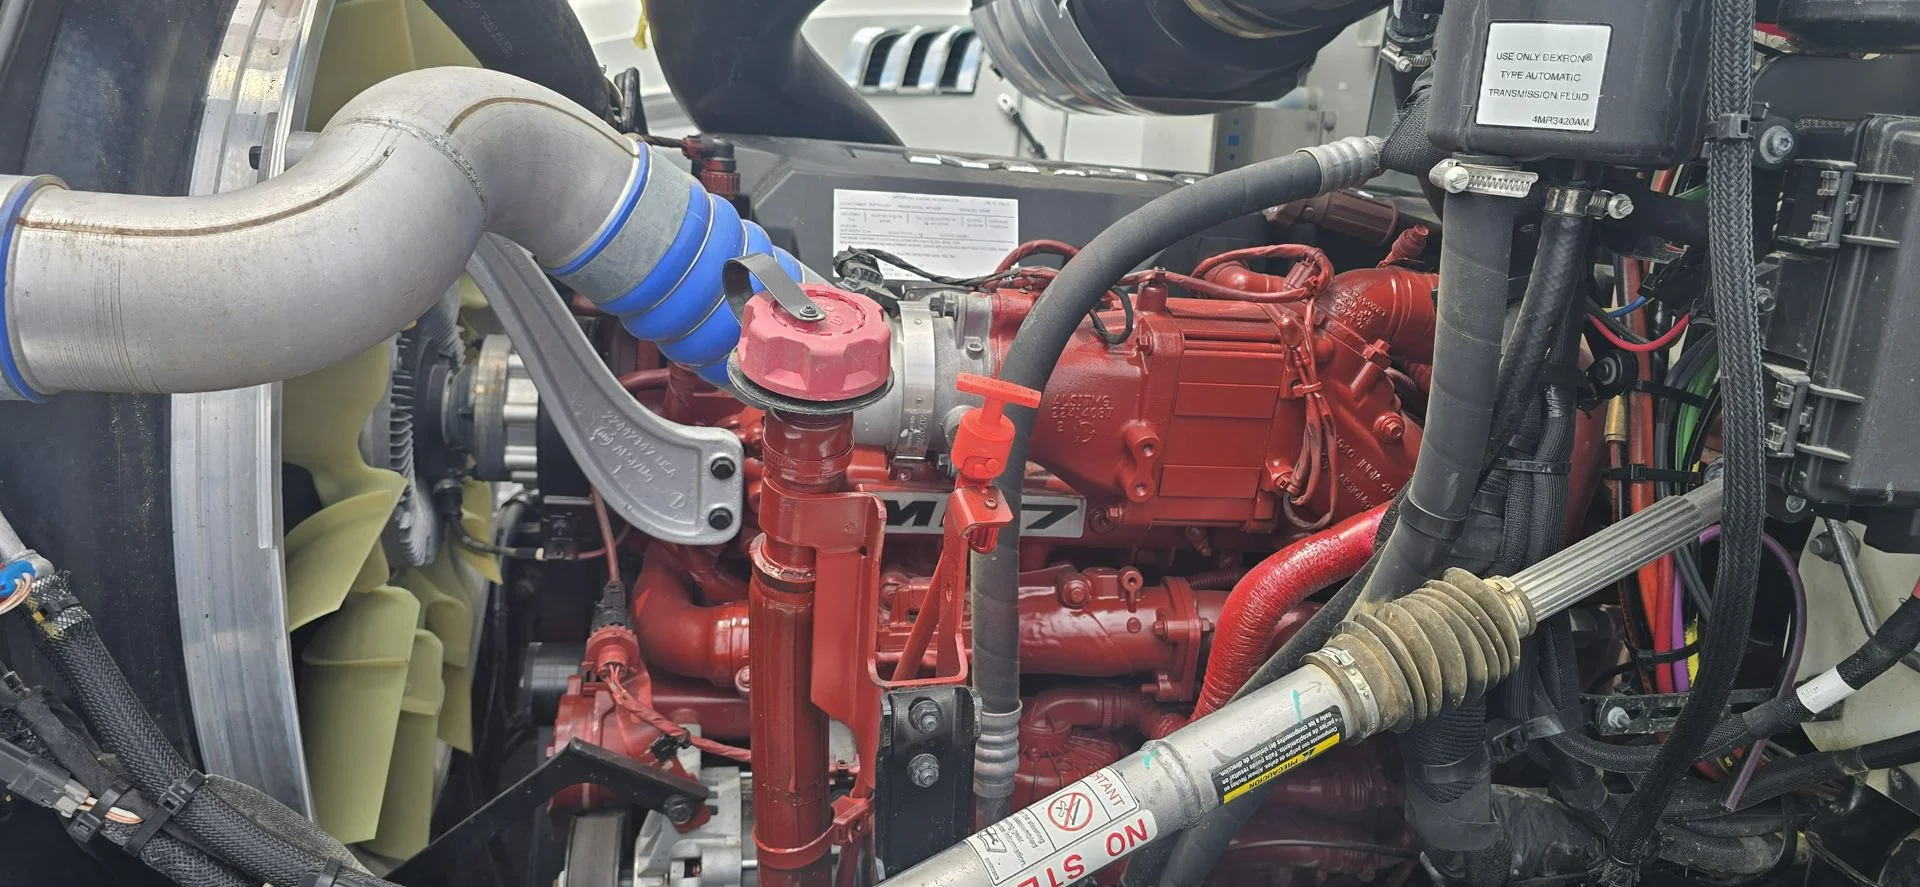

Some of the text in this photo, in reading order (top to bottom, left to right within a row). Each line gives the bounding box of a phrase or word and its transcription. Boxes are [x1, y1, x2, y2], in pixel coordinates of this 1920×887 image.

[1496, 52, 1514, 60] USE
[1516, 52, 1540, 61] ONLY
[1500, 71, 1581, 82] TYPE AUTOMATIC
[1488, 88, 1589, 101] TRANSMISSION FLUID
[1532, 116, 1590, 126] 4MR3420AM
[1307, 720, 1316, 728] los
[1318, 718, 1335, 731] partes
[1276, 723, 1308, 745] componentes
[1310, 726, 1338, 744] Componente
[1268, 742, 1277, 751] del
[1277, 731, 1312, 754] acoplamiento.
[1249, 746, 1269, 760] sistema
[1285, 745, 1302, 758] peligro
[1242, 757, 1250, 765] de
[1249, 757, 1265, 770] puede
[1228, 766, 1249, 782] resultar
[1230, 776, 1248, 788] flechas
[1106, 818, 1148, 857] NO
[1003, 831, 1028, 868] information.
